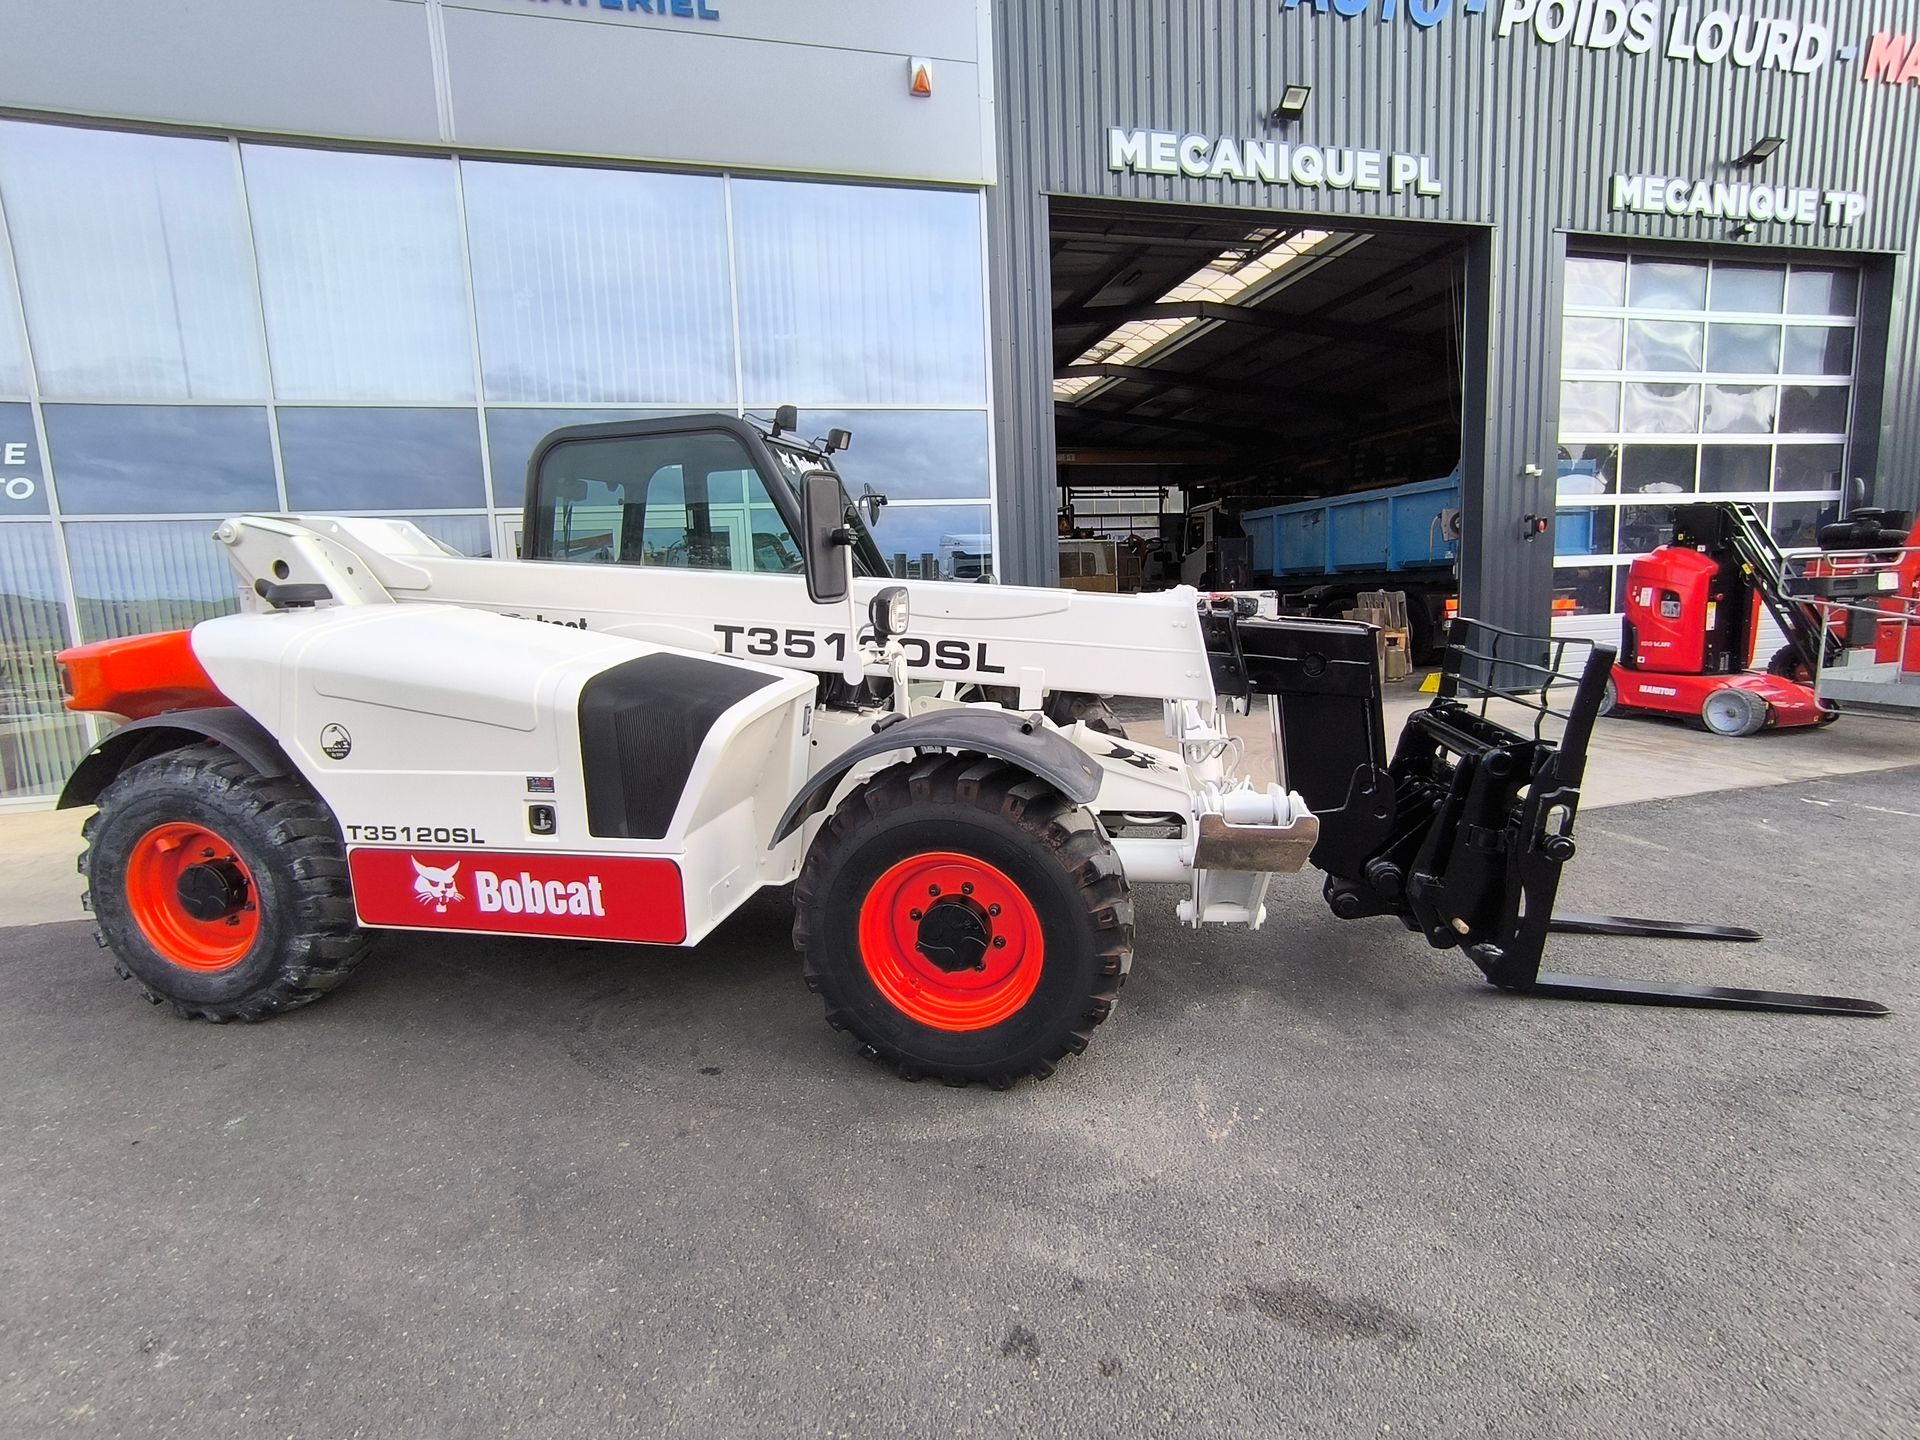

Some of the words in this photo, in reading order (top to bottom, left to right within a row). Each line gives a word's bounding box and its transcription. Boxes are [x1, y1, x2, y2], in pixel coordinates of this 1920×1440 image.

[1498, 0, 1656, 54] POIDS
[1667, 6, 1831, 73] LOURD
[1109, 127, 1381, 187] MECANIQUE
[1392, 153, 1441, 195] PL
[1613, 173, 1819, 224] MECANIQUE
[1825, 190, 1865, 226] TP
[0, 442, 27, 465] E
[713, 624, 1005, 674] T3510SL
[1638, 684, 1676, 696] MANITOU
[347, 825, 485, 844] T35120SL
[474, 870, 605, 917] Bobcat
